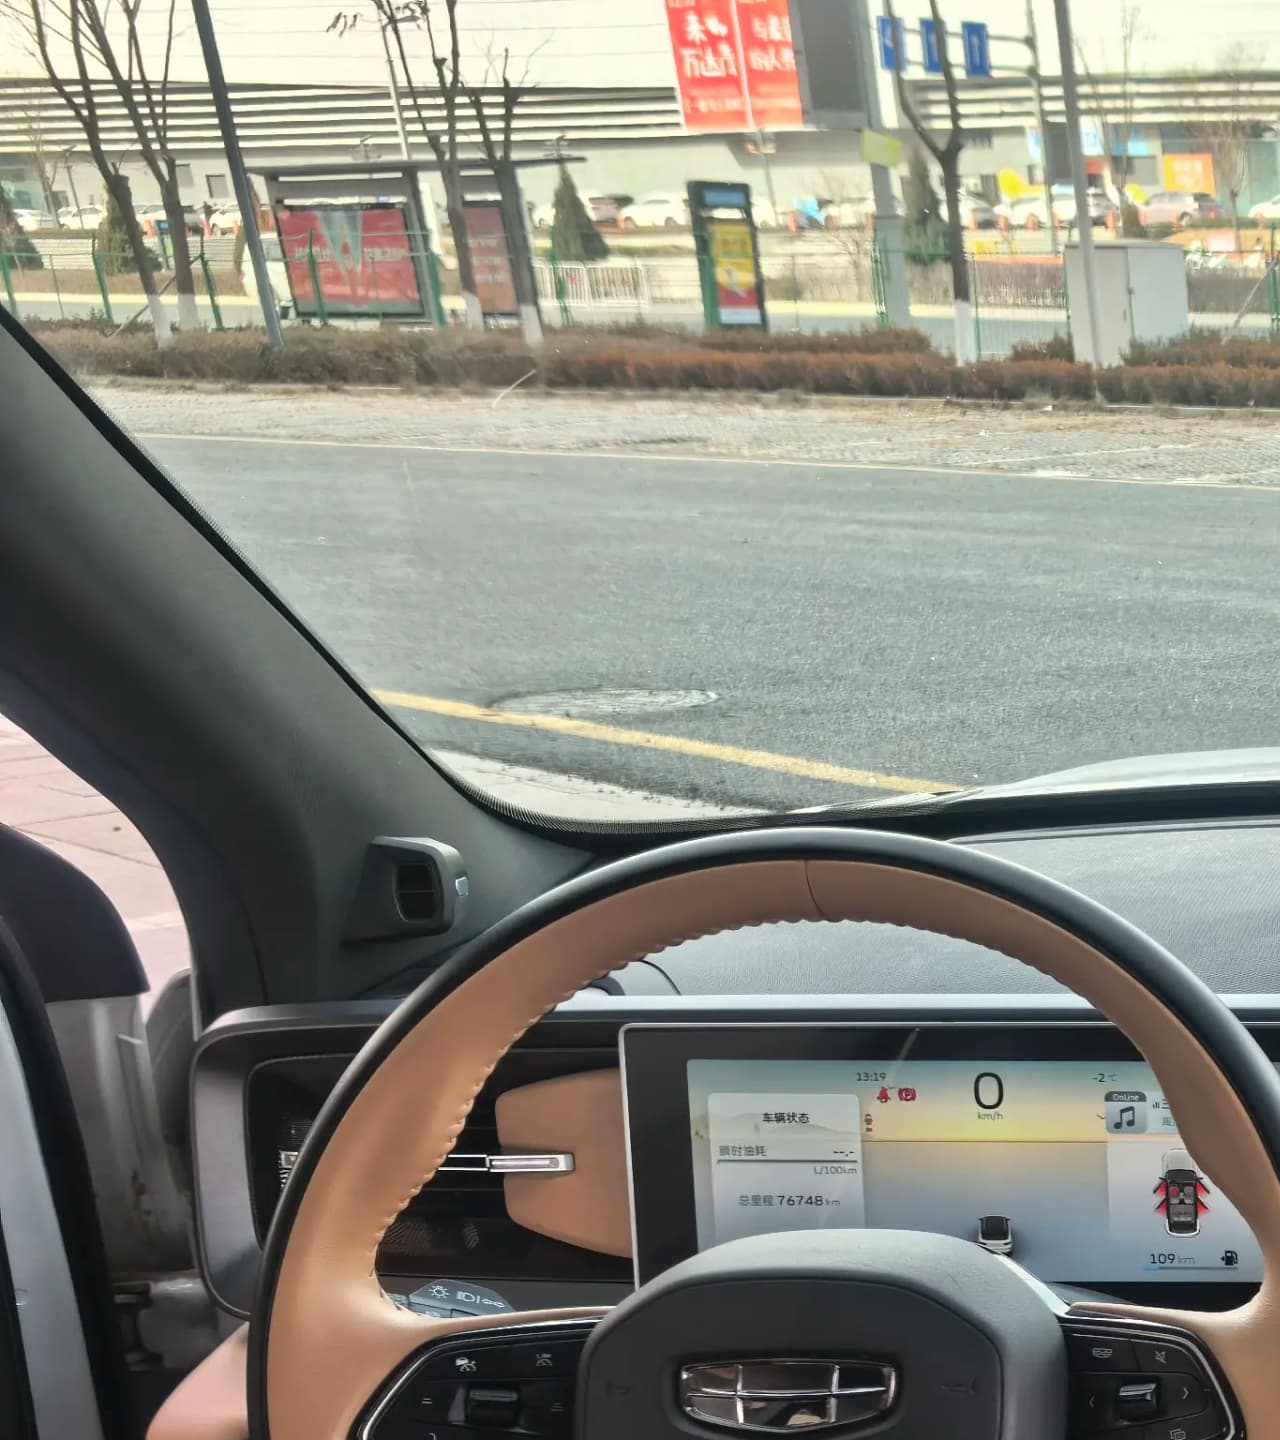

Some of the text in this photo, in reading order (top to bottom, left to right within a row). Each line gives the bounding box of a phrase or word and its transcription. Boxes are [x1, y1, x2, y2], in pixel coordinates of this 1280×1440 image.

[856, 1072, 887, 1082] 13:19
[973, 1072, 1004, 1110] 0
[762, 1112, 810, 1124] 车辆状态
[977, 1111, 1004, 1121] km/h
[777, 1195, 823, 1206] 76748
[1150, 1253, 1176, 1264] 109
